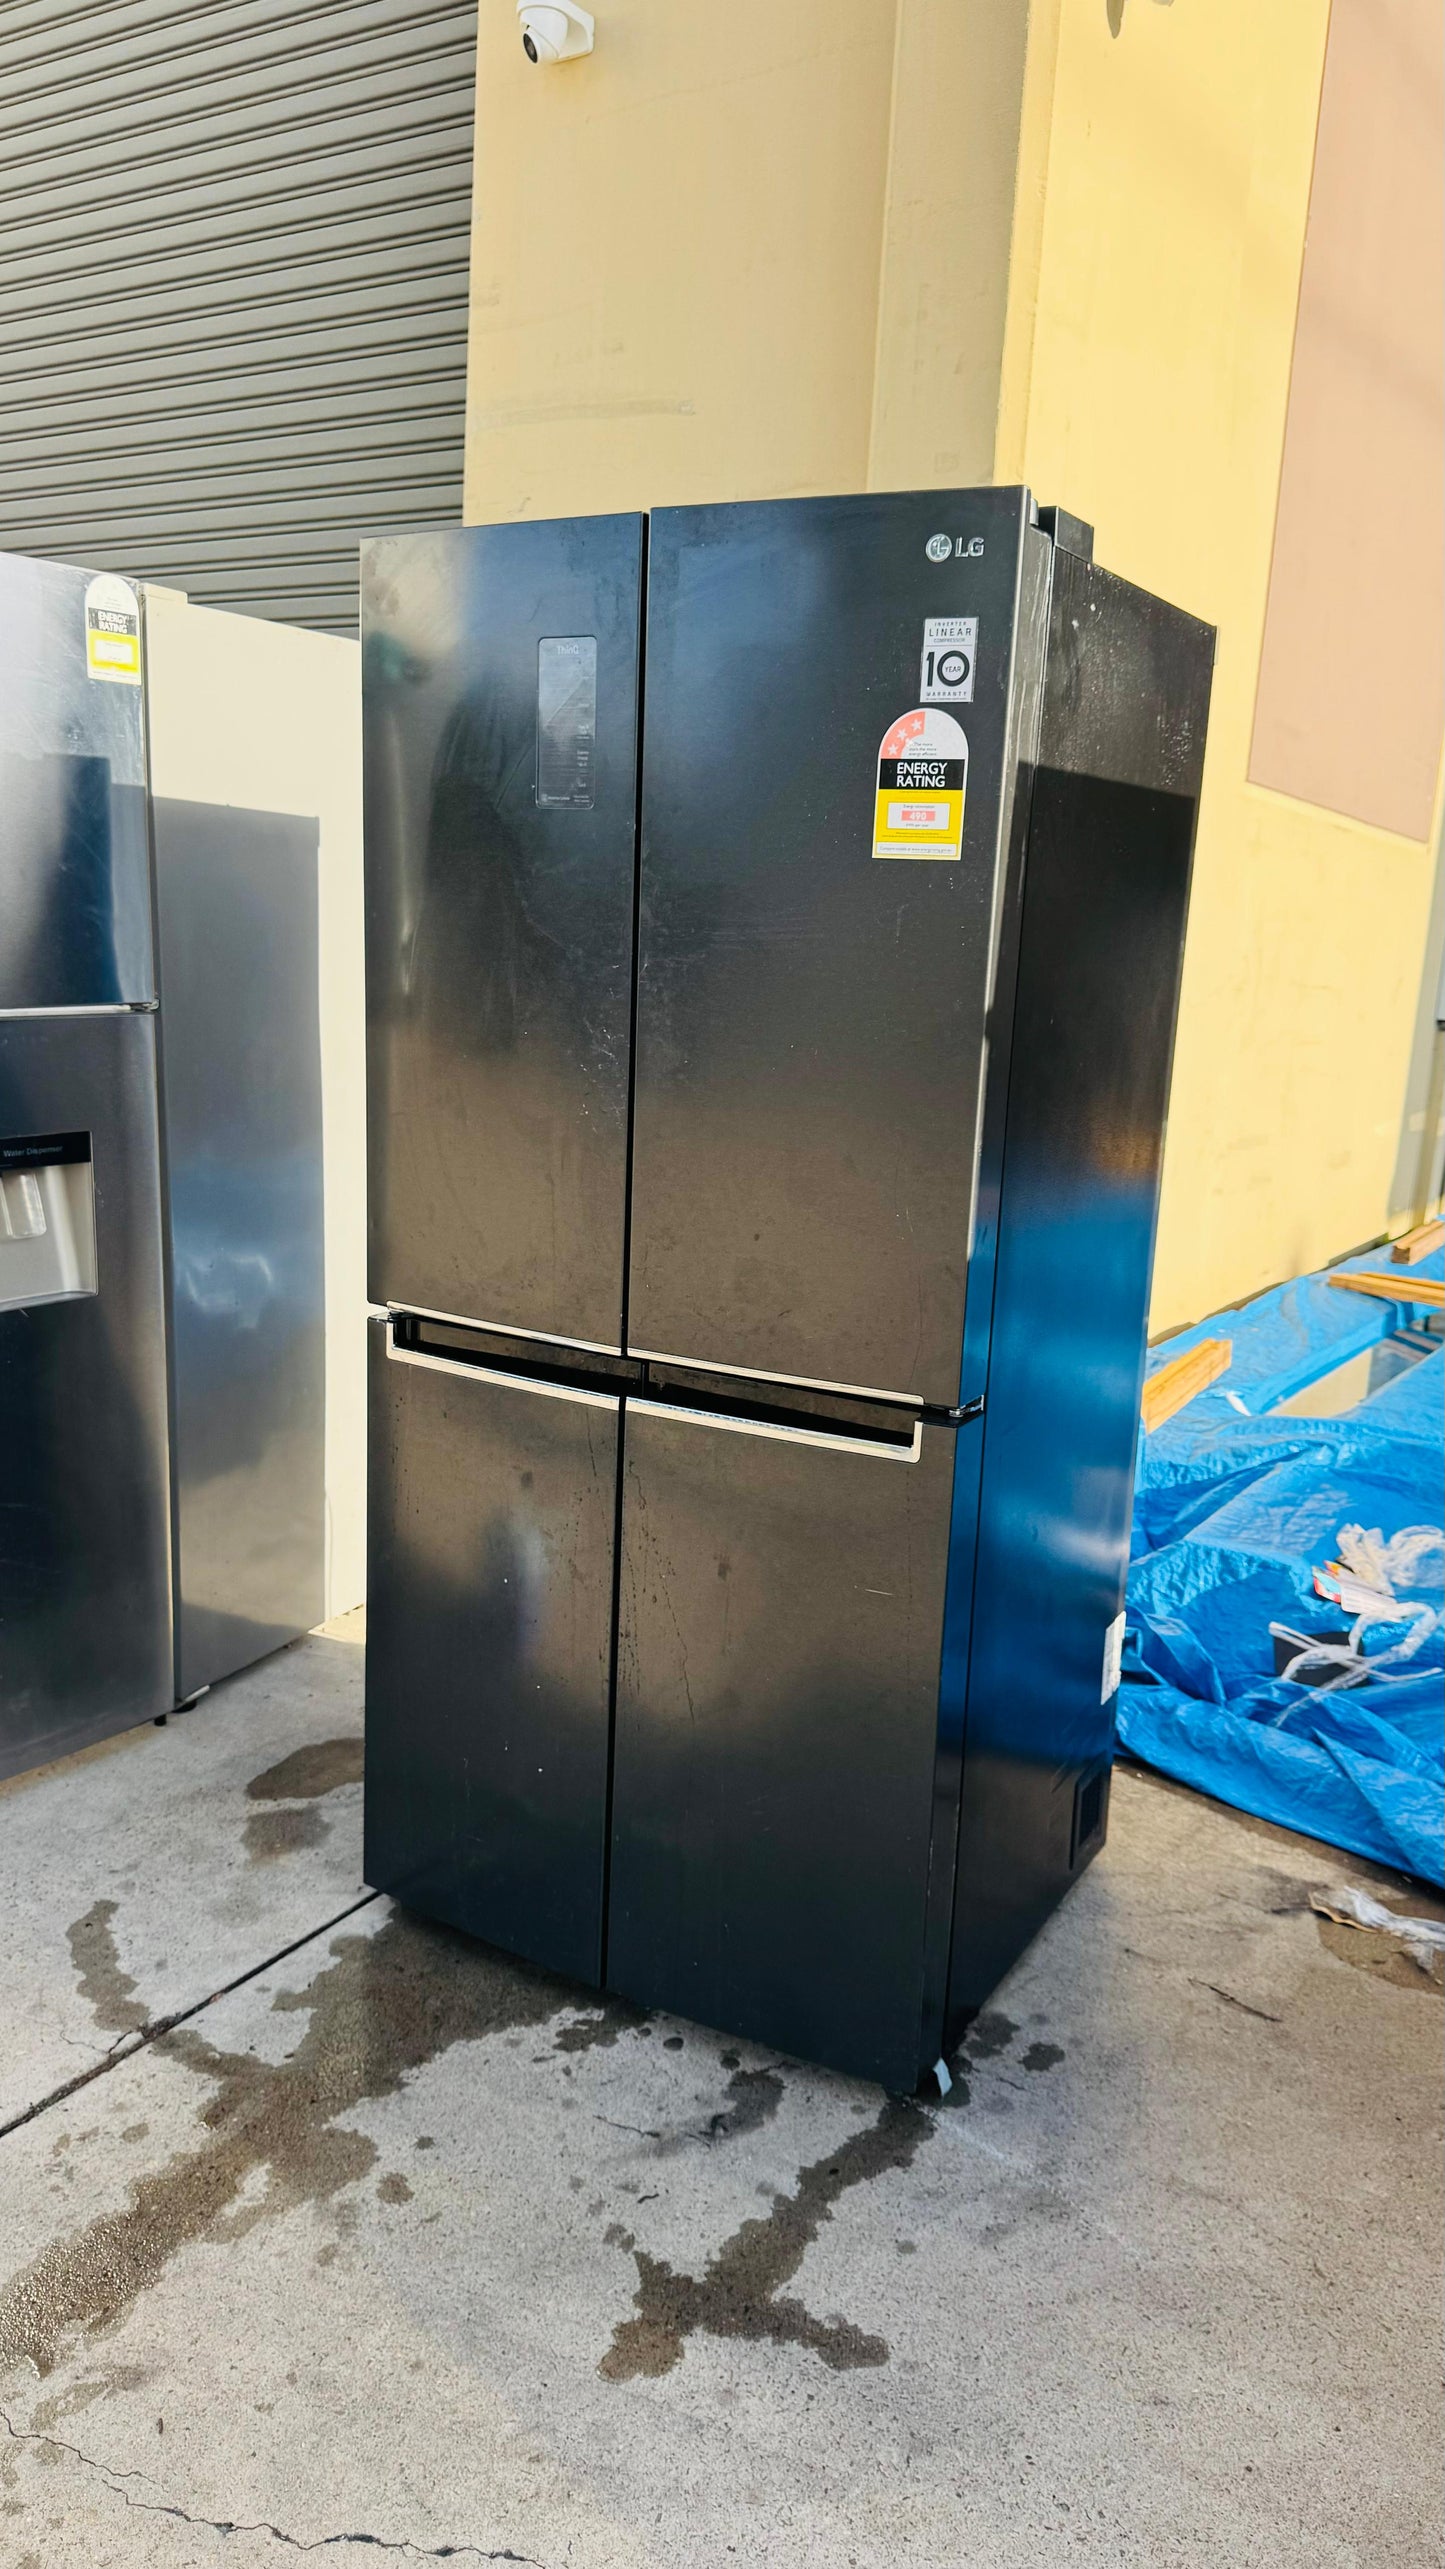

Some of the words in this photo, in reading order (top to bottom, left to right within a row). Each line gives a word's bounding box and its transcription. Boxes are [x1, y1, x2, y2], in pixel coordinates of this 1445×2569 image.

[954, 537, 985, 557] LG
[97, 610, 128, 625] ENERGY
[98, 620, 128, 634] RATING
[928, 628, 972, 637] LINEAR
[926, 650, 970, 687] 10
[896, 762, 948, 775] ENERGY
[896, 775, 946, 788] RATING
[909, 811, 927, 820] 490
[3, 1149, 25, 1157] Water
